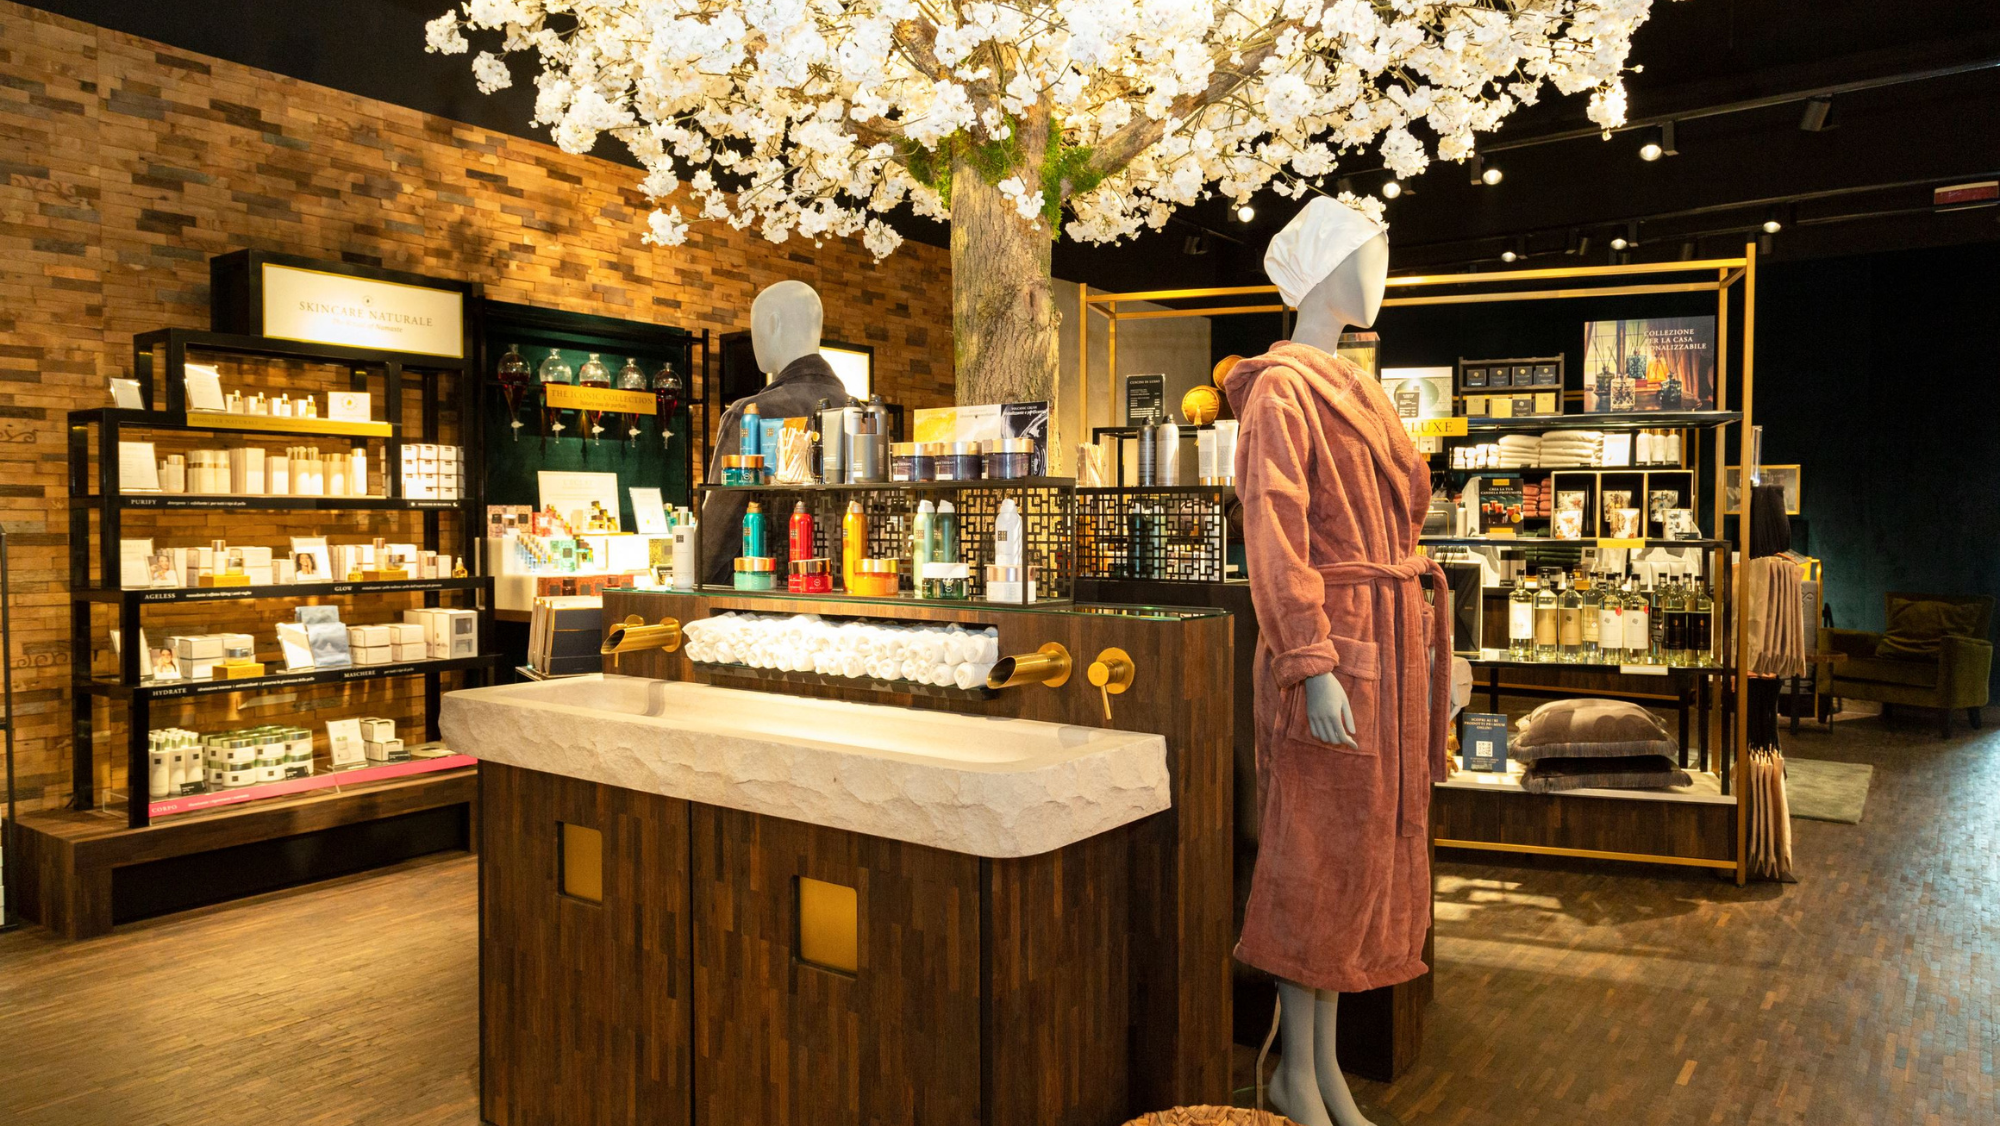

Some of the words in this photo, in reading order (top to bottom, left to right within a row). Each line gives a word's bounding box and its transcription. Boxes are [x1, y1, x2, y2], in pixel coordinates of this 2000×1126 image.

[299, 301, 363, 318] SKINCARE
[369, 311, 433, 327] NATURALE
[376, 323, 403, 333] Namaste
[1643, 328, 1695, 337] COLLEZIONE
[551, 389, 569, 398] THE
[571, 390, 600, 400] ICONIC
[603, 394, 653, 405] COLLECTION
[1402, 421, 1453, 433] ELUXE
[344, 669, 376, 678] MASCHERE
[152, 688, 187, 696] HYDRATE
[152, 804, 177, 813] CORPO
